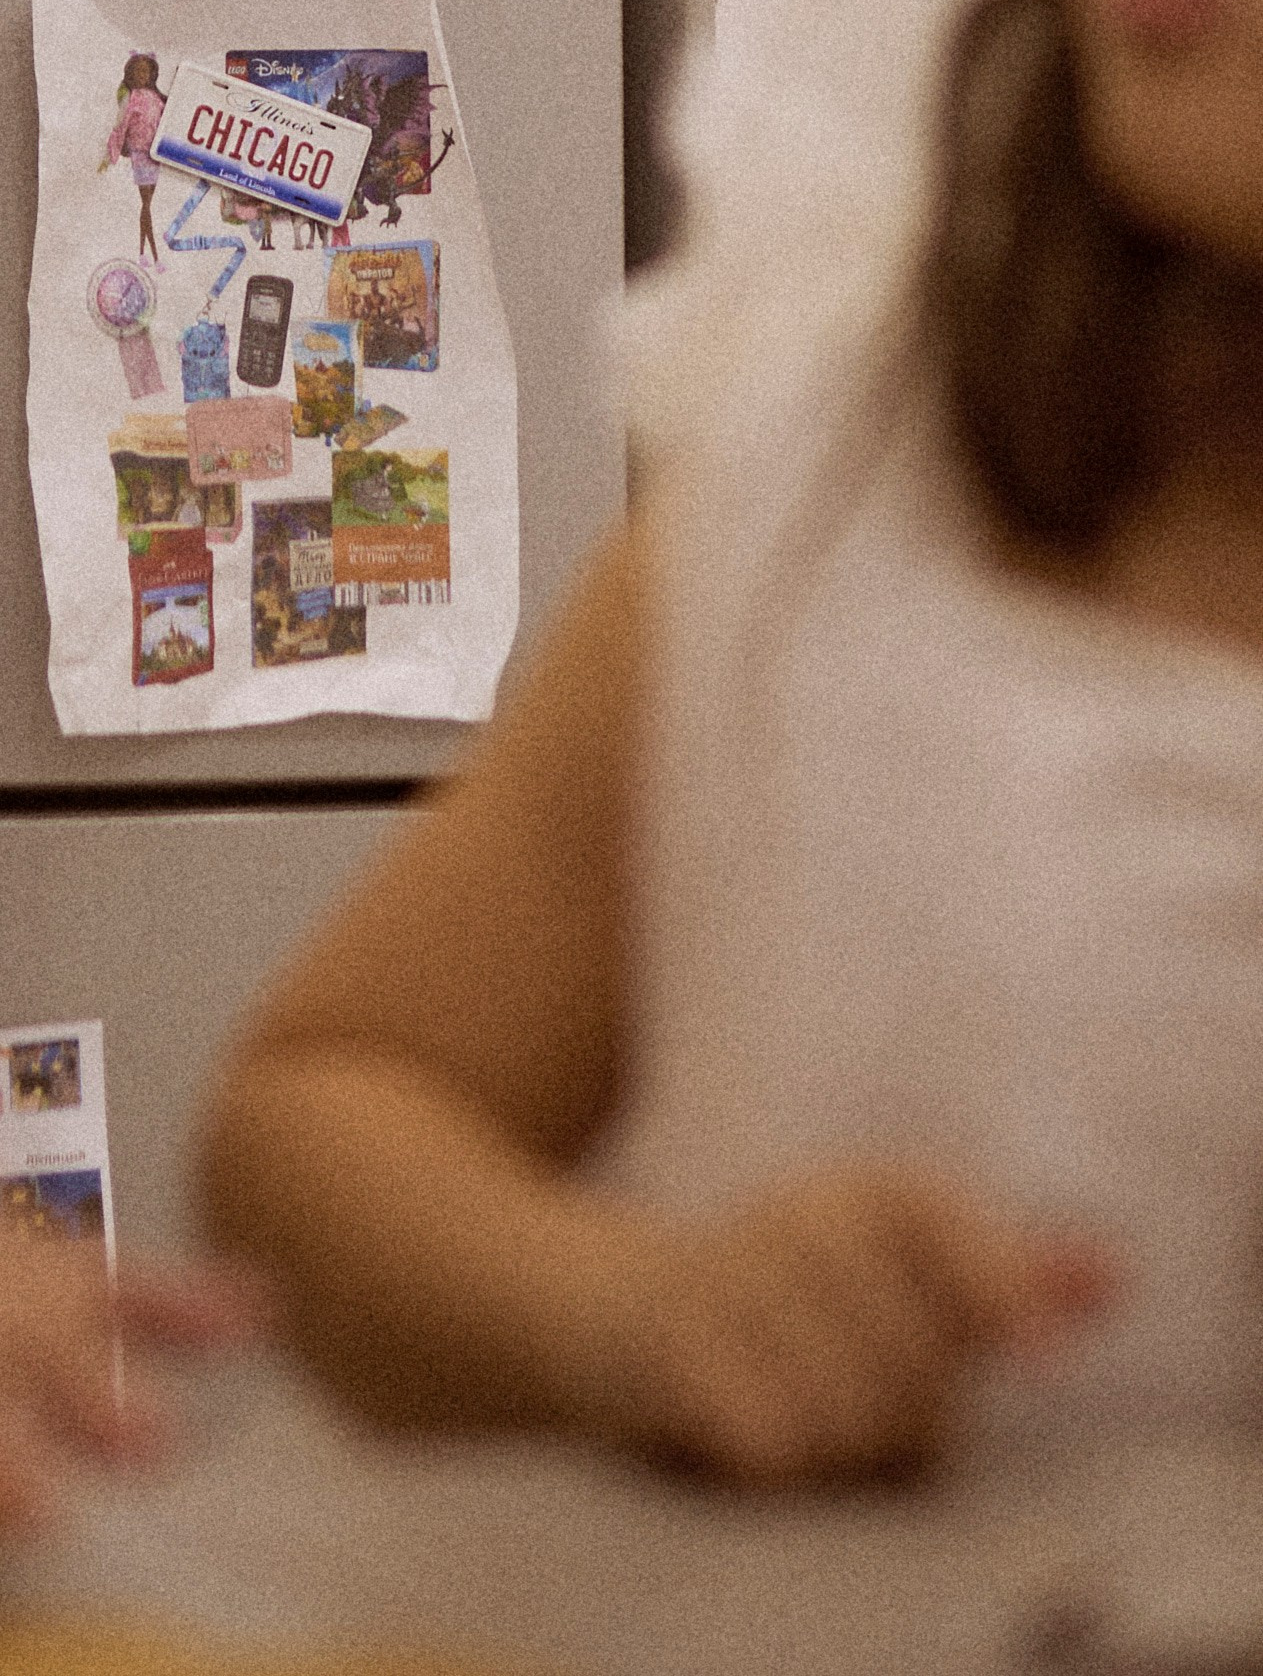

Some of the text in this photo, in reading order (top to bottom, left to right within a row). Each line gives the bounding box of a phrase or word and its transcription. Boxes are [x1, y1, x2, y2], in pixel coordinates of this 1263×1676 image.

[251, 56, 304, 82] Disney
[226, 91, 316, 137] Illinois
[186, 104, 335, 190] CHICAGO
